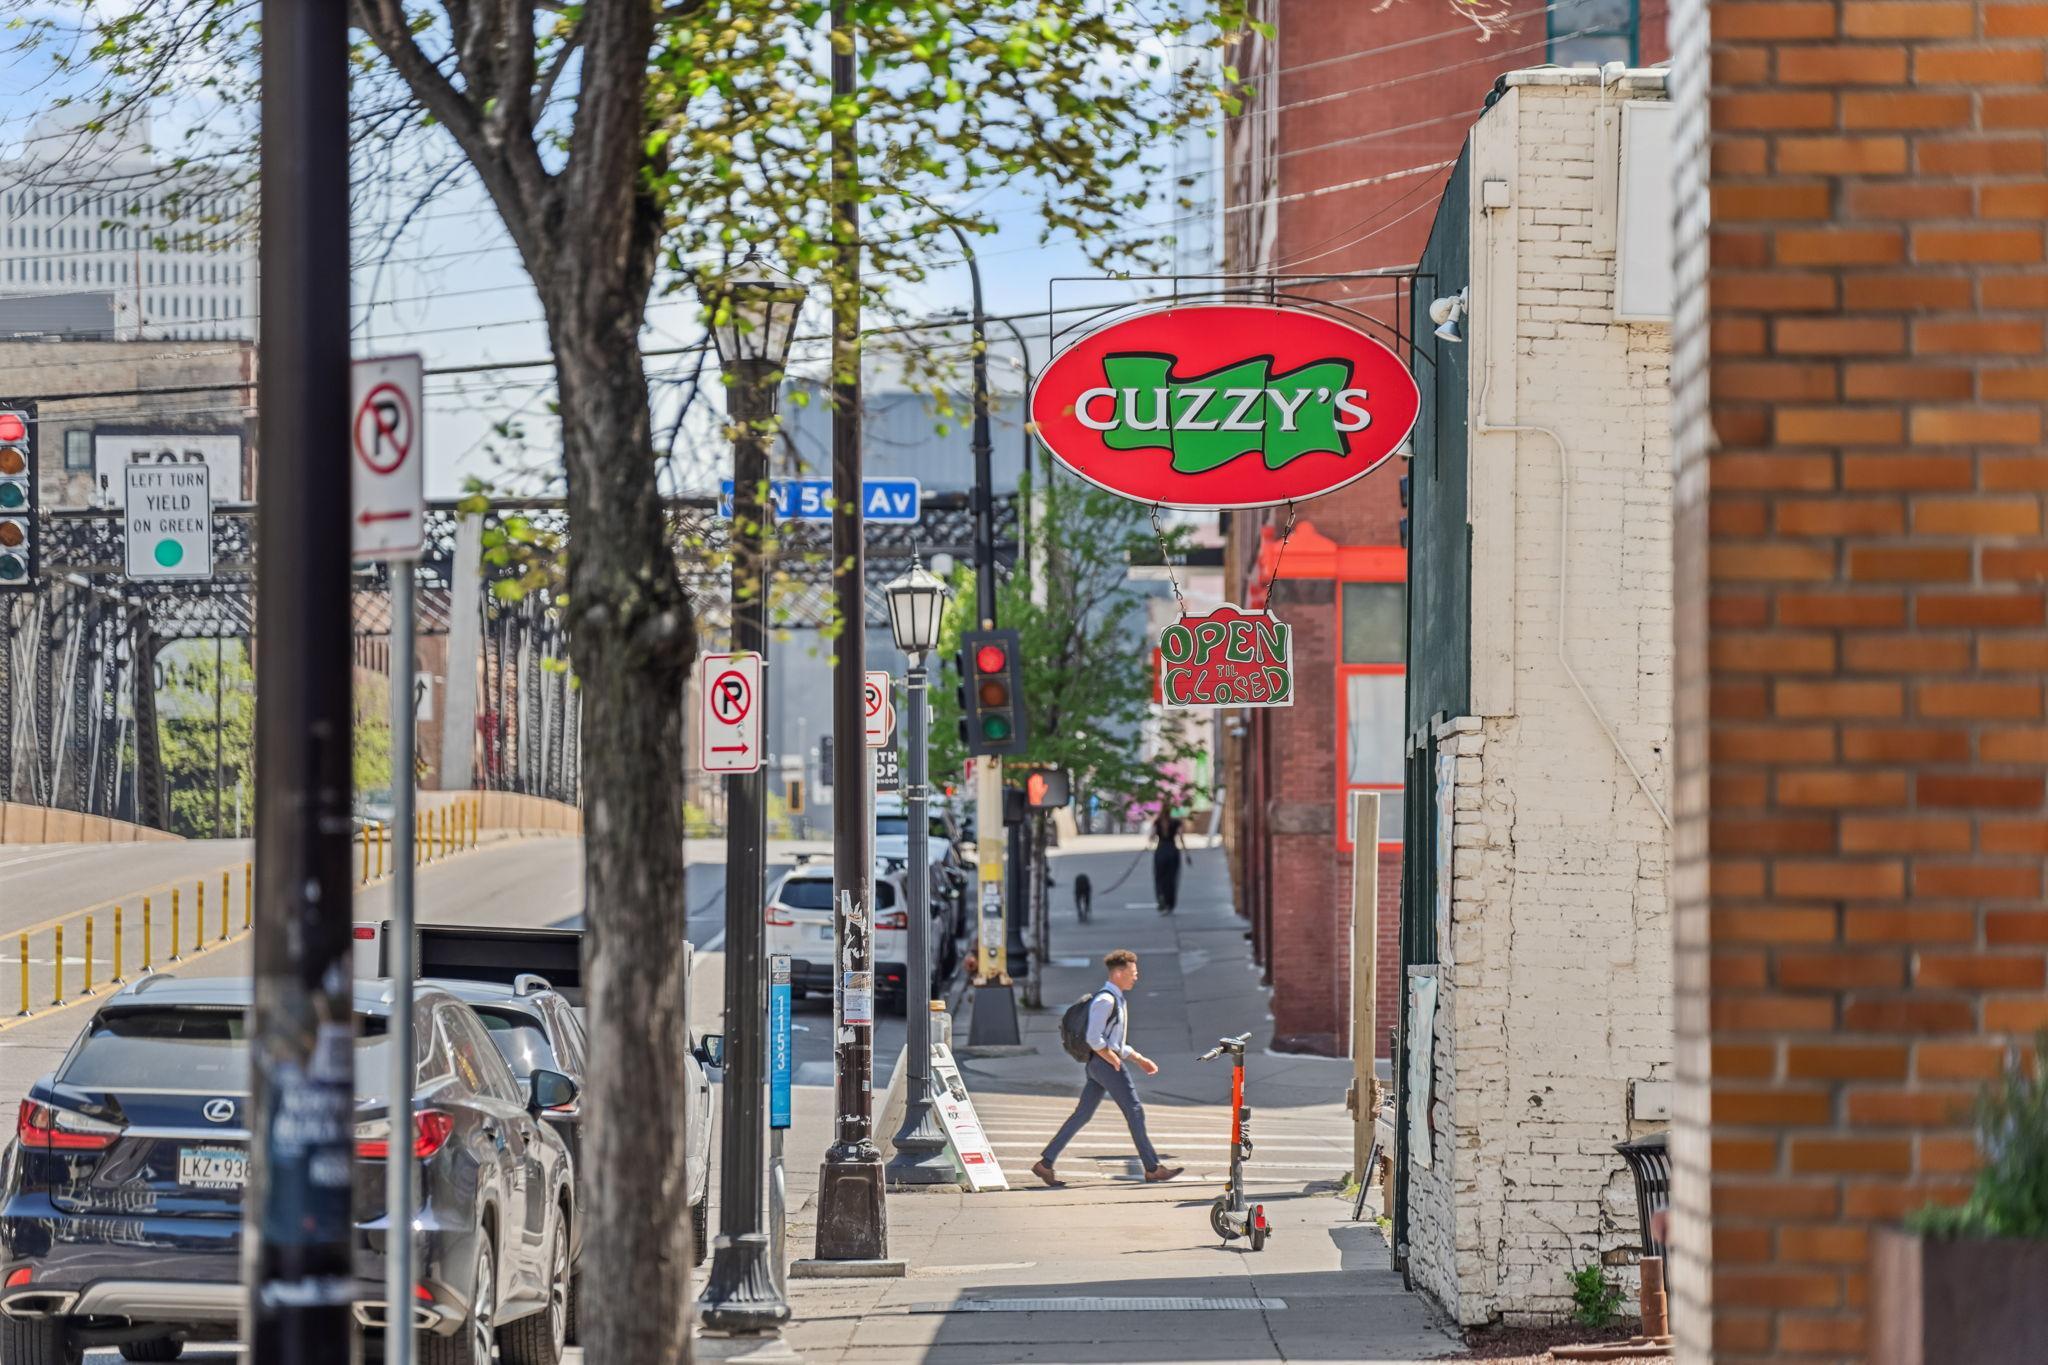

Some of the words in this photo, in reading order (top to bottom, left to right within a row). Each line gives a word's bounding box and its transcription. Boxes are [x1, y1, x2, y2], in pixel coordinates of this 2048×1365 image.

[1075, 387, 1372, 432] CUZZY'S
[131, 473, 163, 488] LEFT
[170, 473, 204, 487] TURN
[147, 495, 191, 511] YIELD
[770, 486, 788, 512] N
[868, 487, 910, 513] Av
[134, 519, 151, 533] ON
[160, 519, 204, 533] GREEN
[1160, 620, 1288, 665] OPEN
[1216, 665, 1238, 678] TIL
[1164, 666, 1291, 706] CLOSED
